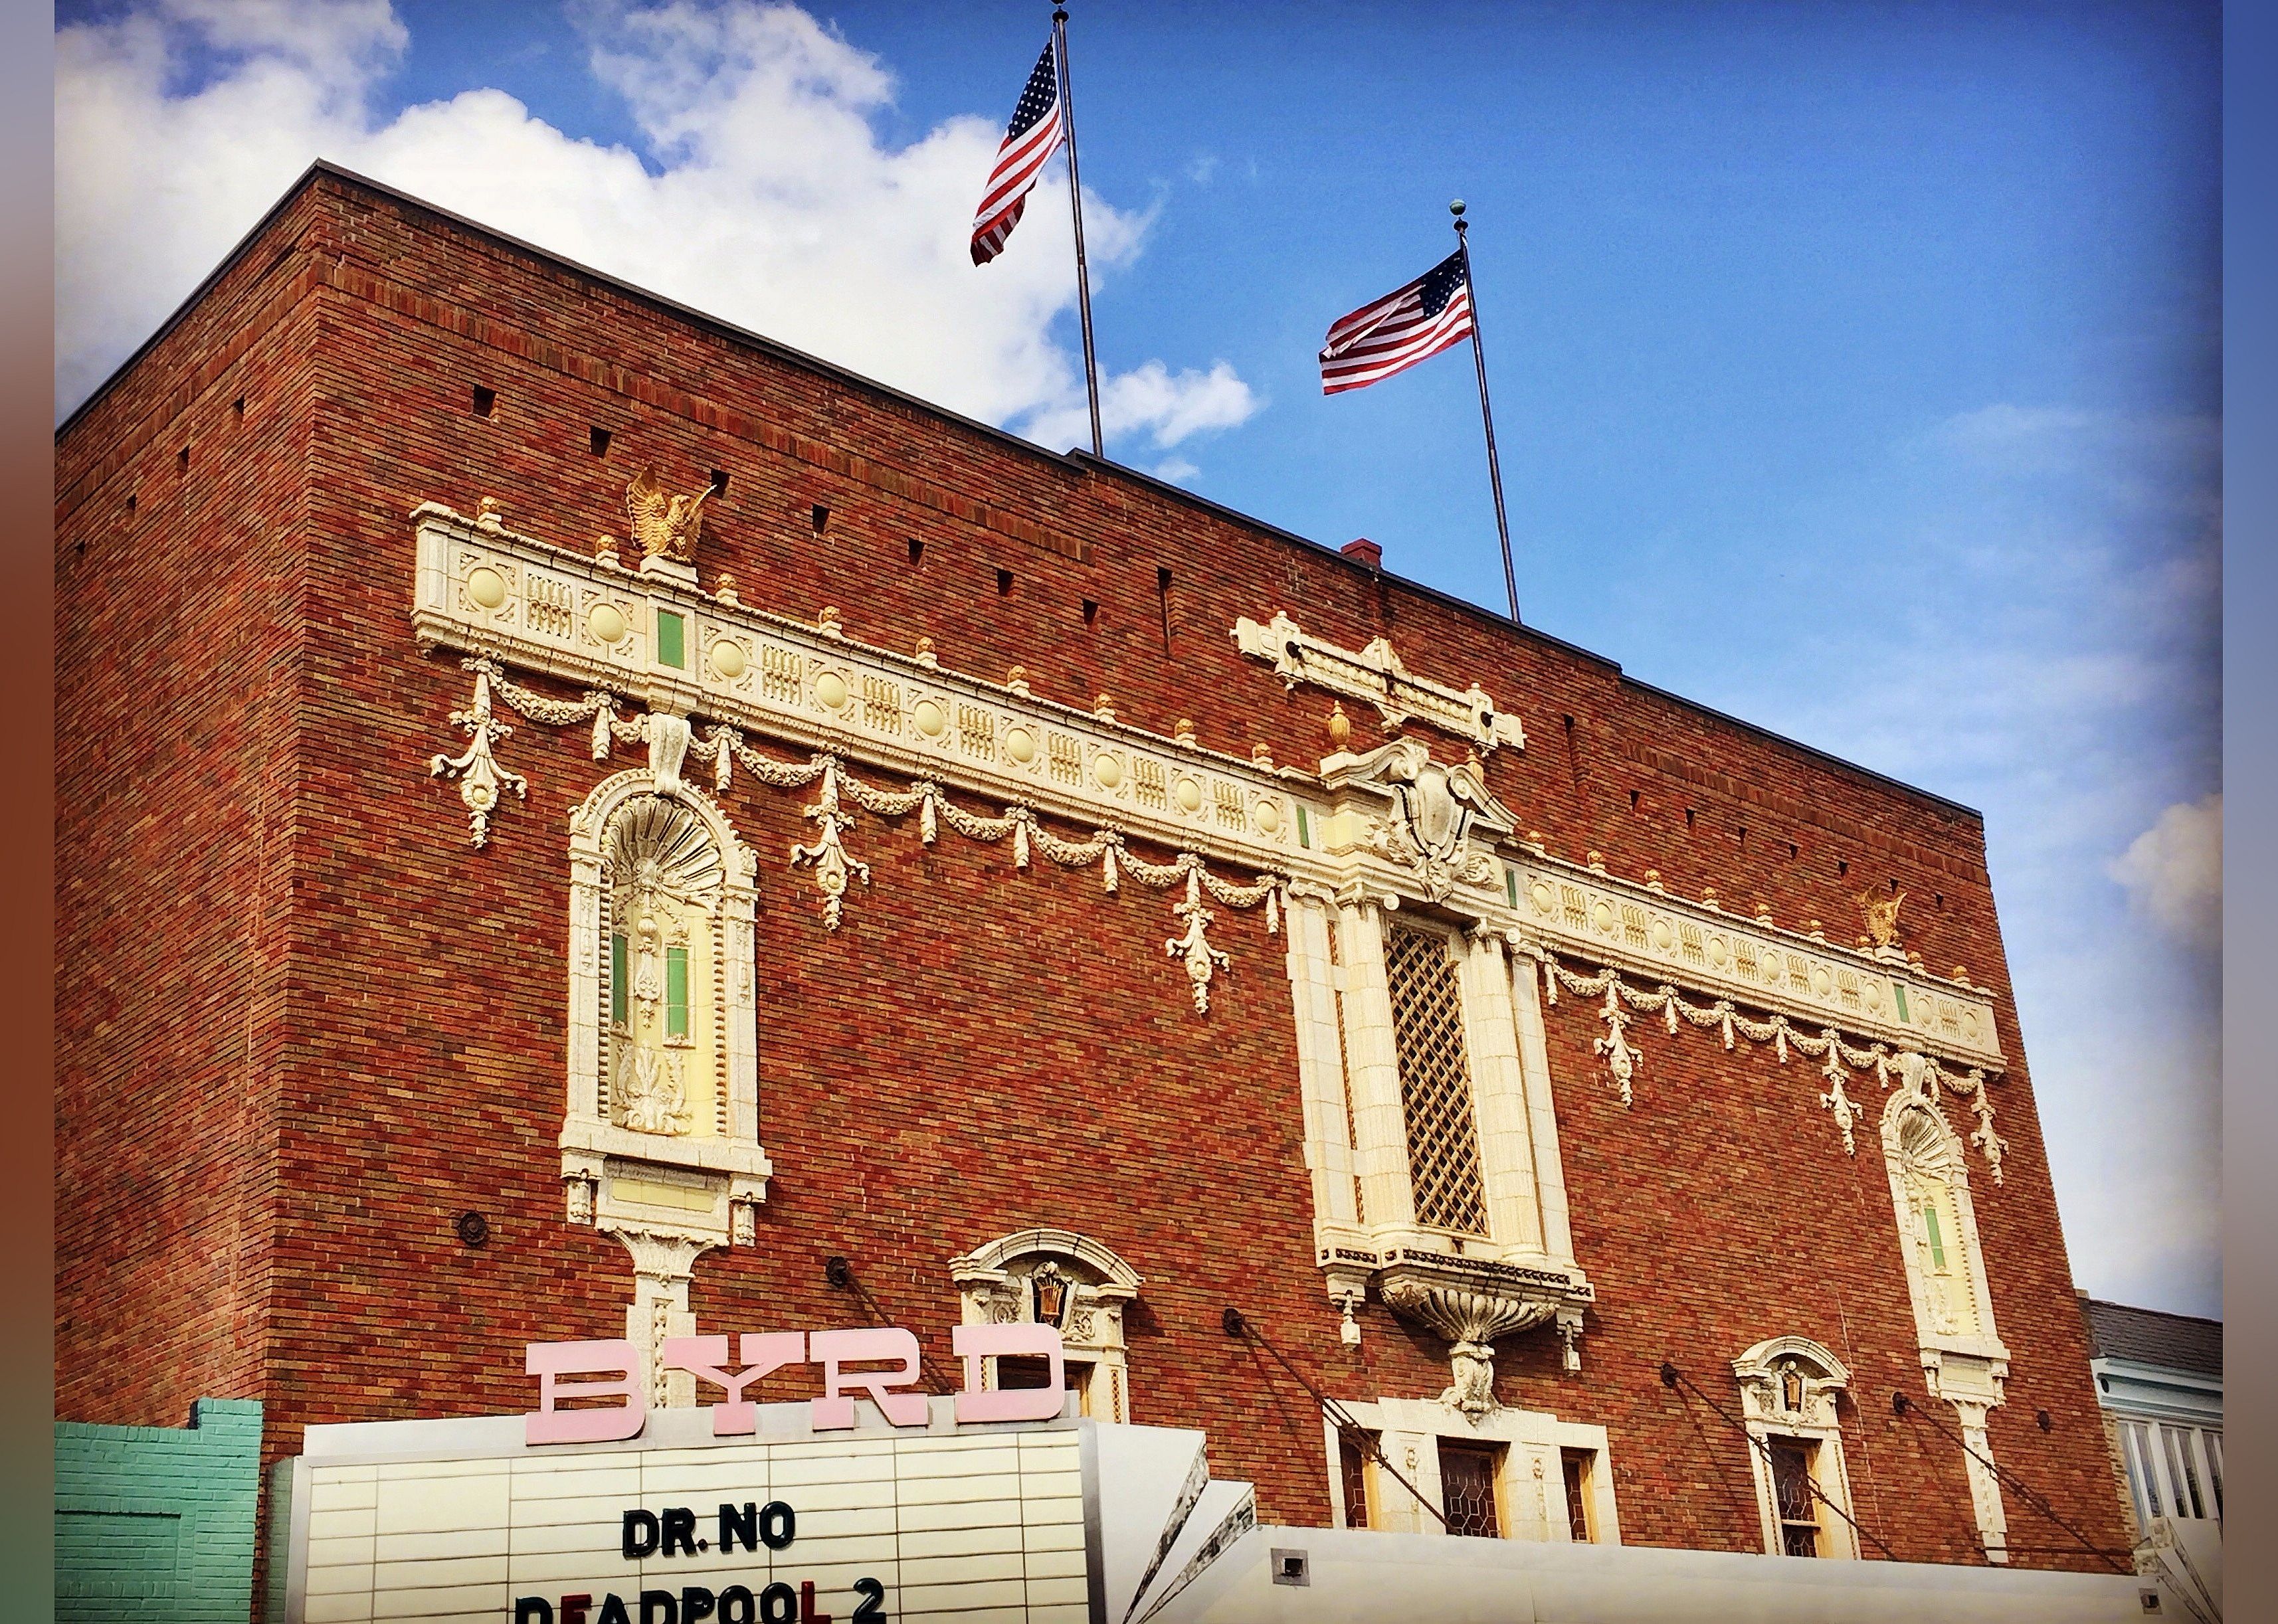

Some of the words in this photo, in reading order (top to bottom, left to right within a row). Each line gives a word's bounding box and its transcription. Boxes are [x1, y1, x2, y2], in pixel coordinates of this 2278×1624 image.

[525, 1324, 1066, 1445] BYRD
[719, 1501, 795, 1553] NO
[514, 1581, 832, 1624] DEADPOOL
[852, 1578, 887, 1624] 2
